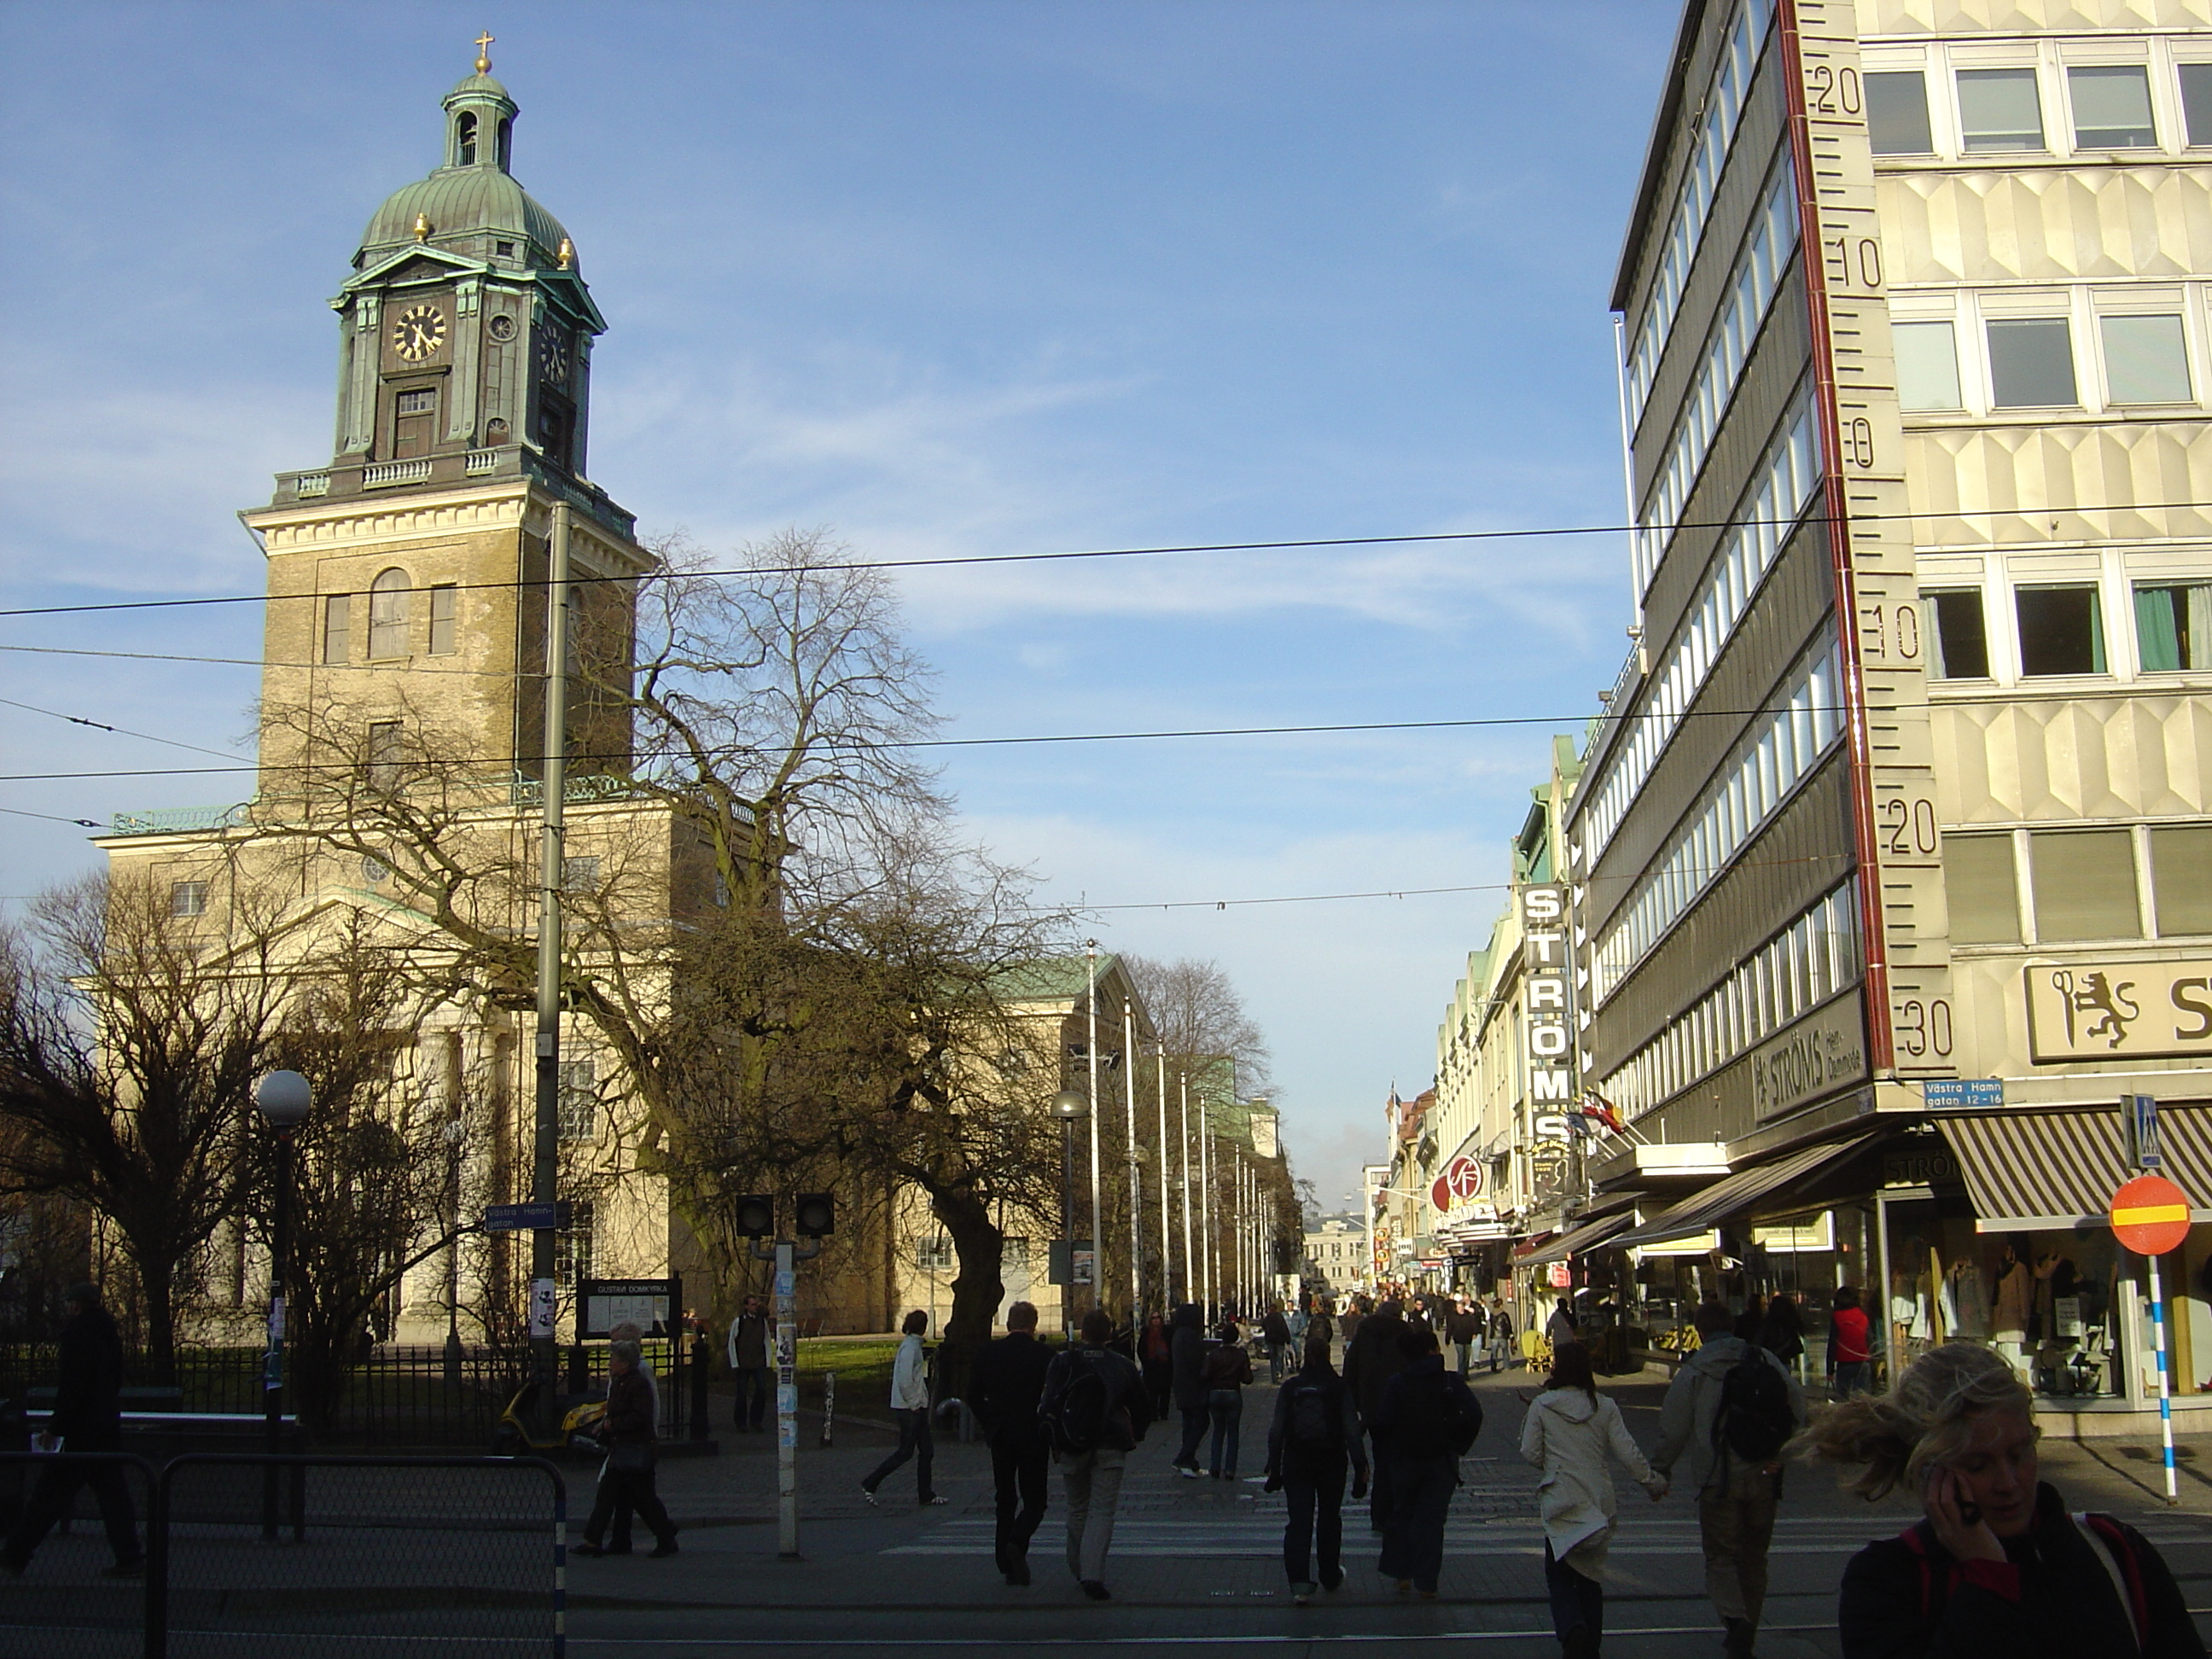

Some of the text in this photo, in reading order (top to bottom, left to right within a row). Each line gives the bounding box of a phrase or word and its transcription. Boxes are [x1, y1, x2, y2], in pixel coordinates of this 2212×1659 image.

[1813, 65, 1861, 114] 20
[1835, 237, 1881, 288] 10
[1871, 604, 1919, 660] 10
[1887, 797, 1937, 855] 20
[1525, 888, 1570, 1144] STRÖMS
[1903, 998, 1953, 1057] 30
[1770, 1028, 1824, 1106] STRÖMS
[1926, 1082, 2001, 1093] Västra Hamn
[1927, 1097, 1959, 1108] gatan
[487, 1208, 517, 1217] Västra
[487, 1220, 514, 1229] gatan
[597, 1285, 667, 1294] GUSTAVI DOMKYRKA
